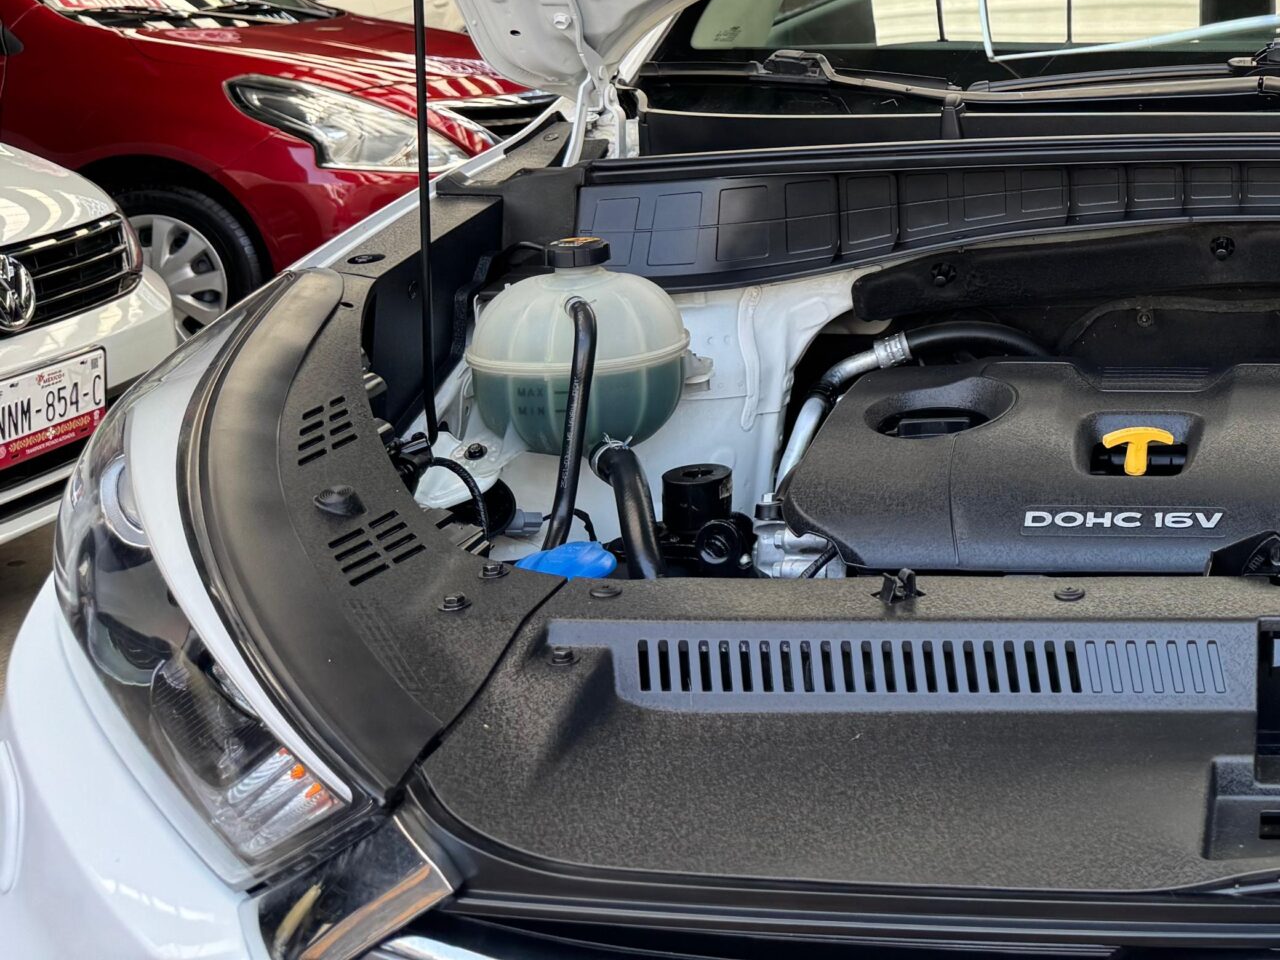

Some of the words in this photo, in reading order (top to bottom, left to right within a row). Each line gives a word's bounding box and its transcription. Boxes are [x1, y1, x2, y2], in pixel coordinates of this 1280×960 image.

[517, 387, 544, 397] MAX
[518, 406, 545, 416] MIN
[1024, 511, 1143, 528] DOHC
[1154, 512, 1224, 528] 16V
